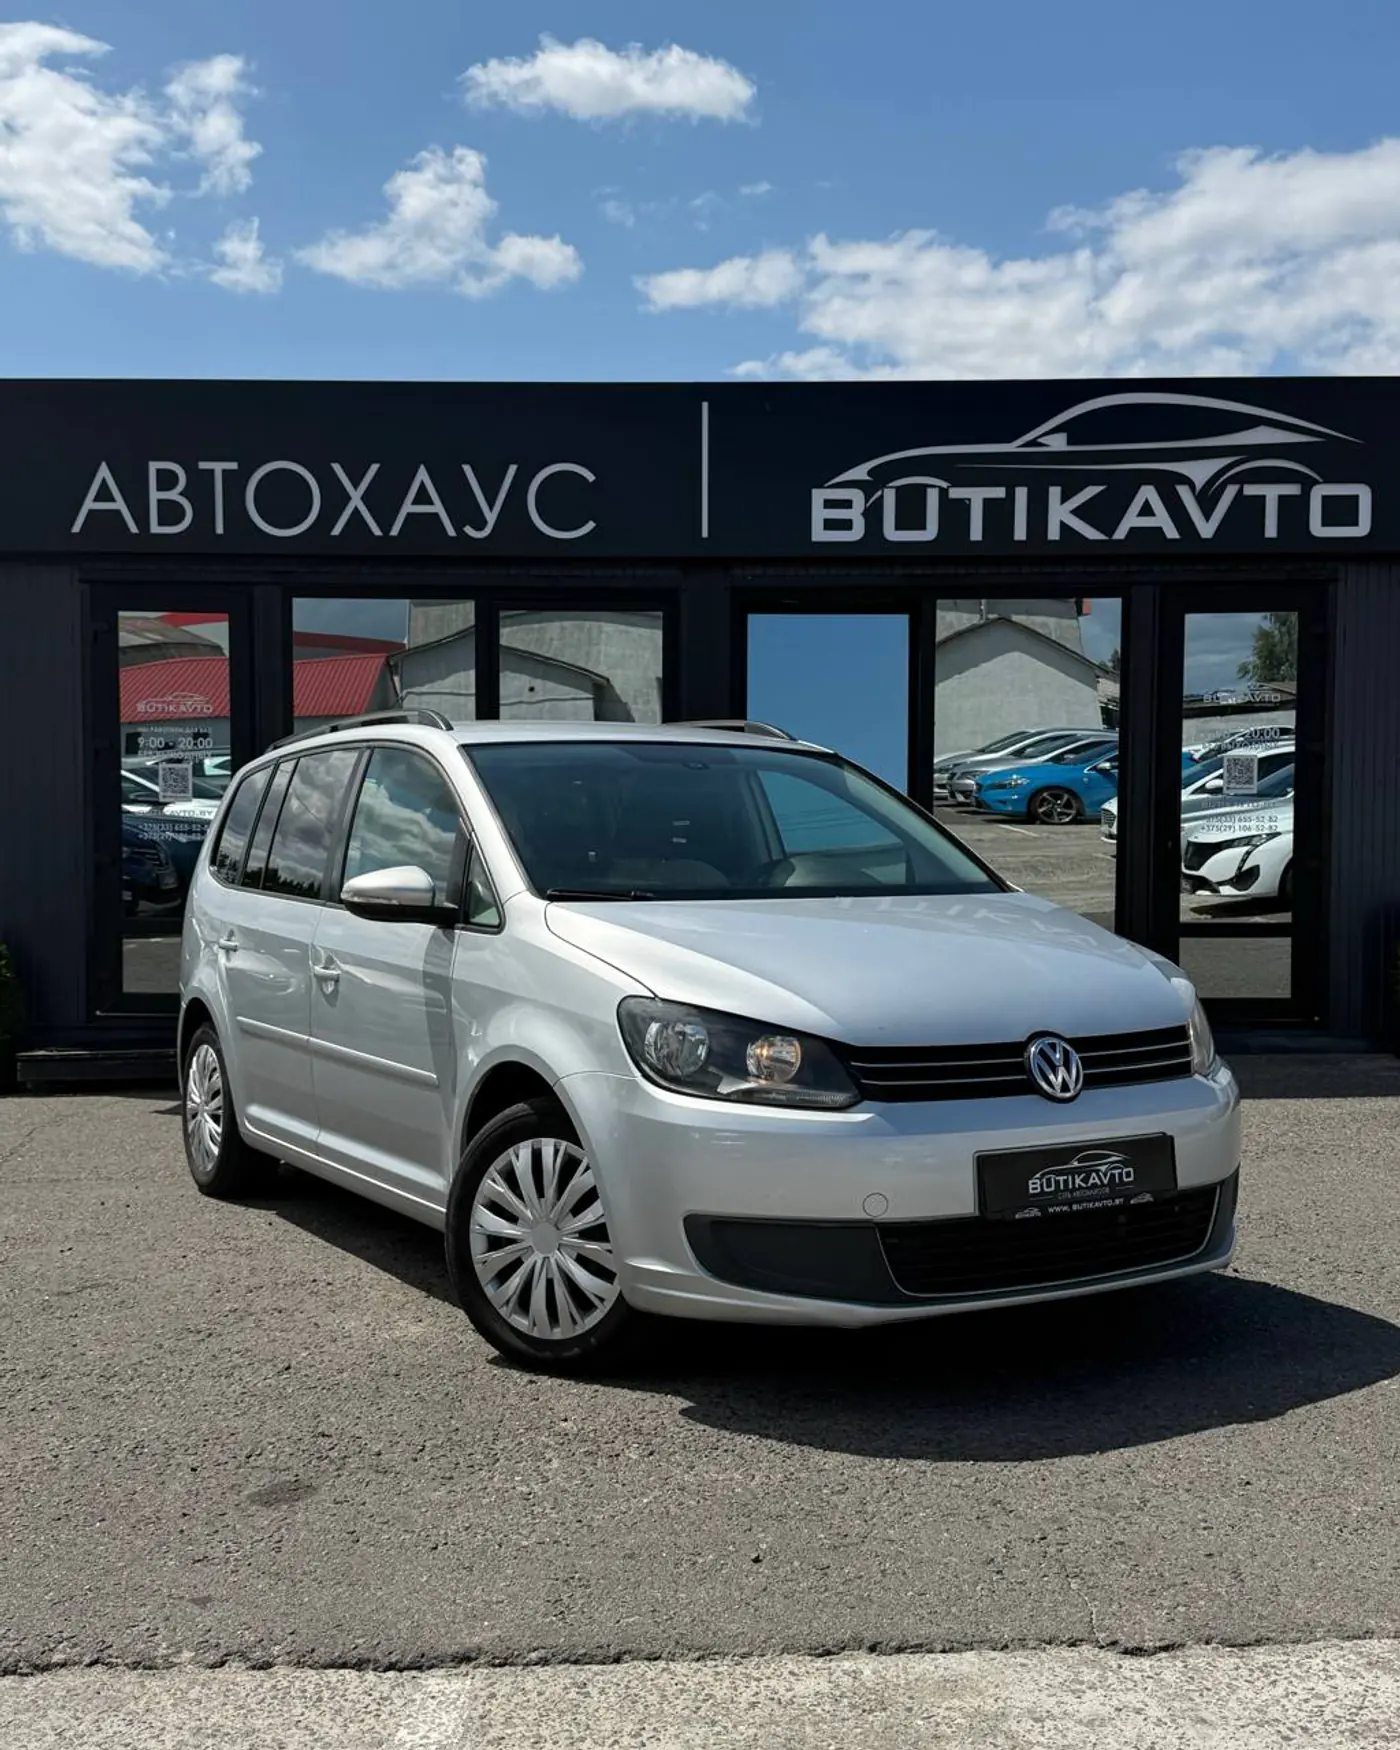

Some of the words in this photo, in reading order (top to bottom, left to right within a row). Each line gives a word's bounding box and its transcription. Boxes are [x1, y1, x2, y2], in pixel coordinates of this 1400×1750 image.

[71, 460, 597, 540] АВТОХАУС
[811, 483, 1372, 542] BUTIKAVTO
[137, 736, 165, 749] 9:00
[178, 736, 213, 749] 20:00
[1031, 1038, 1082, 1098] VW
[1028, 1167, 1135, 1194] BUTIKAVTO
